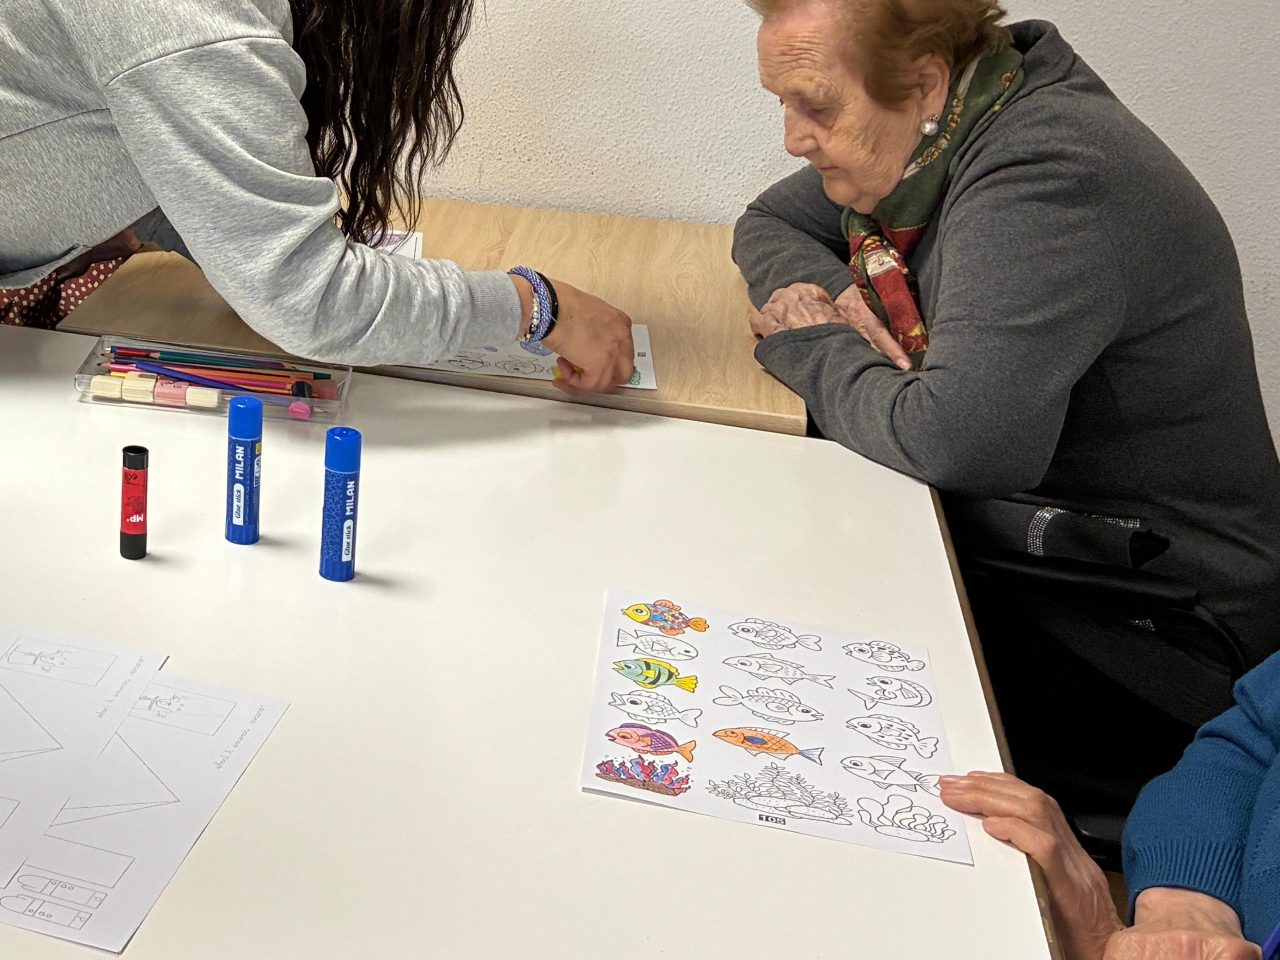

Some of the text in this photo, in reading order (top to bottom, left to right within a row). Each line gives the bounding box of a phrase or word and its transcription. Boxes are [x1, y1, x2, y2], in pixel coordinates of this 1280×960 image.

[234, 445, 245, 480] MILAN
[234, 488, 242, 519] Glue stick
[345, 480, 355, 516] MILAN
[343, 524, 352, 556] Glue stick
